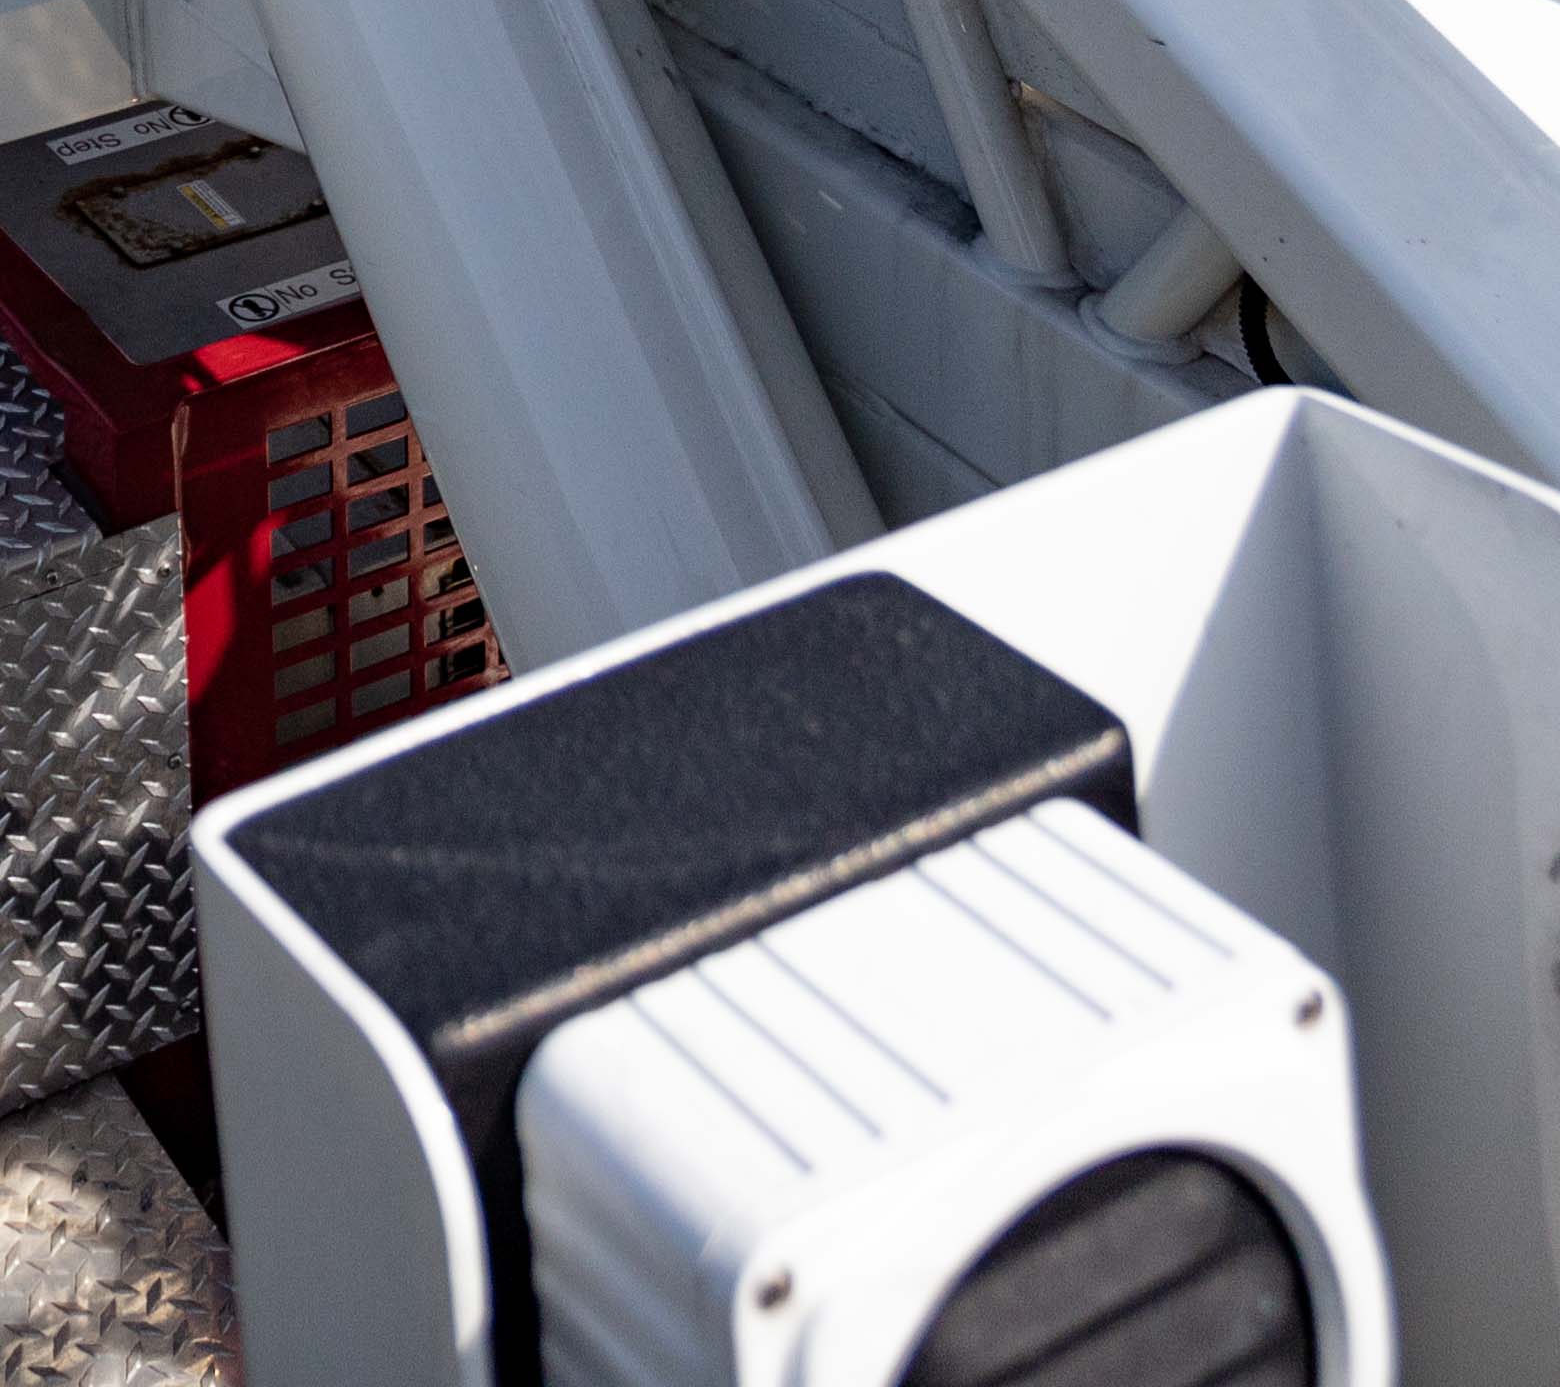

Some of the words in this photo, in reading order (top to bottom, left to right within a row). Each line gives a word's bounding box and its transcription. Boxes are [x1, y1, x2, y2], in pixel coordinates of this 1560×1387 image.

[134, 118, 173, 135] No
[57, 133, 121, 157] Step
[274, 285, 318, 304] No
